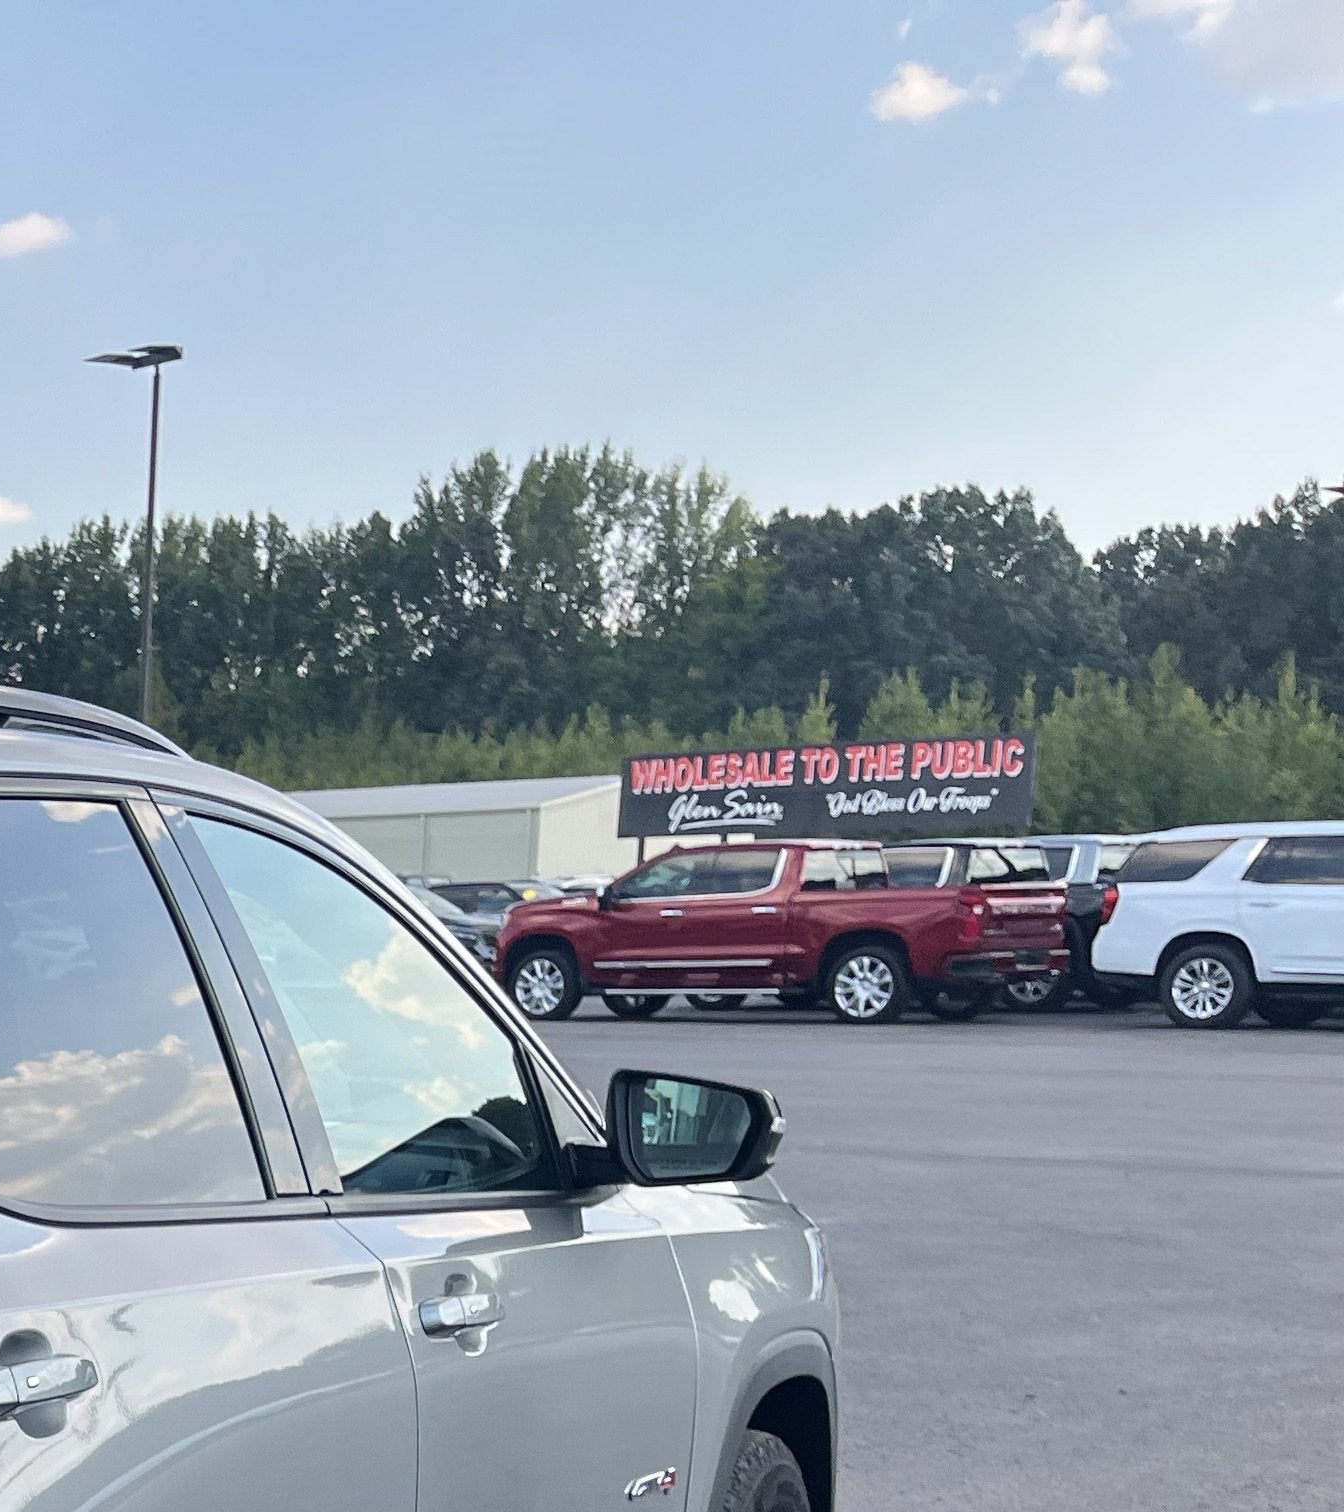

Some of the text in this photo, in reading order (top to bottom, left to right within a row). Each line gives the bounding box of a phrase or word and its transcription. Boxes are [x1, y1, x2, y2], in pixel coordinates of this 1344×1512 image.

[630, 738, 1025, 795] WHOLESALE TO THE PUBLIC
[667, 793, 723, 834] Glen
